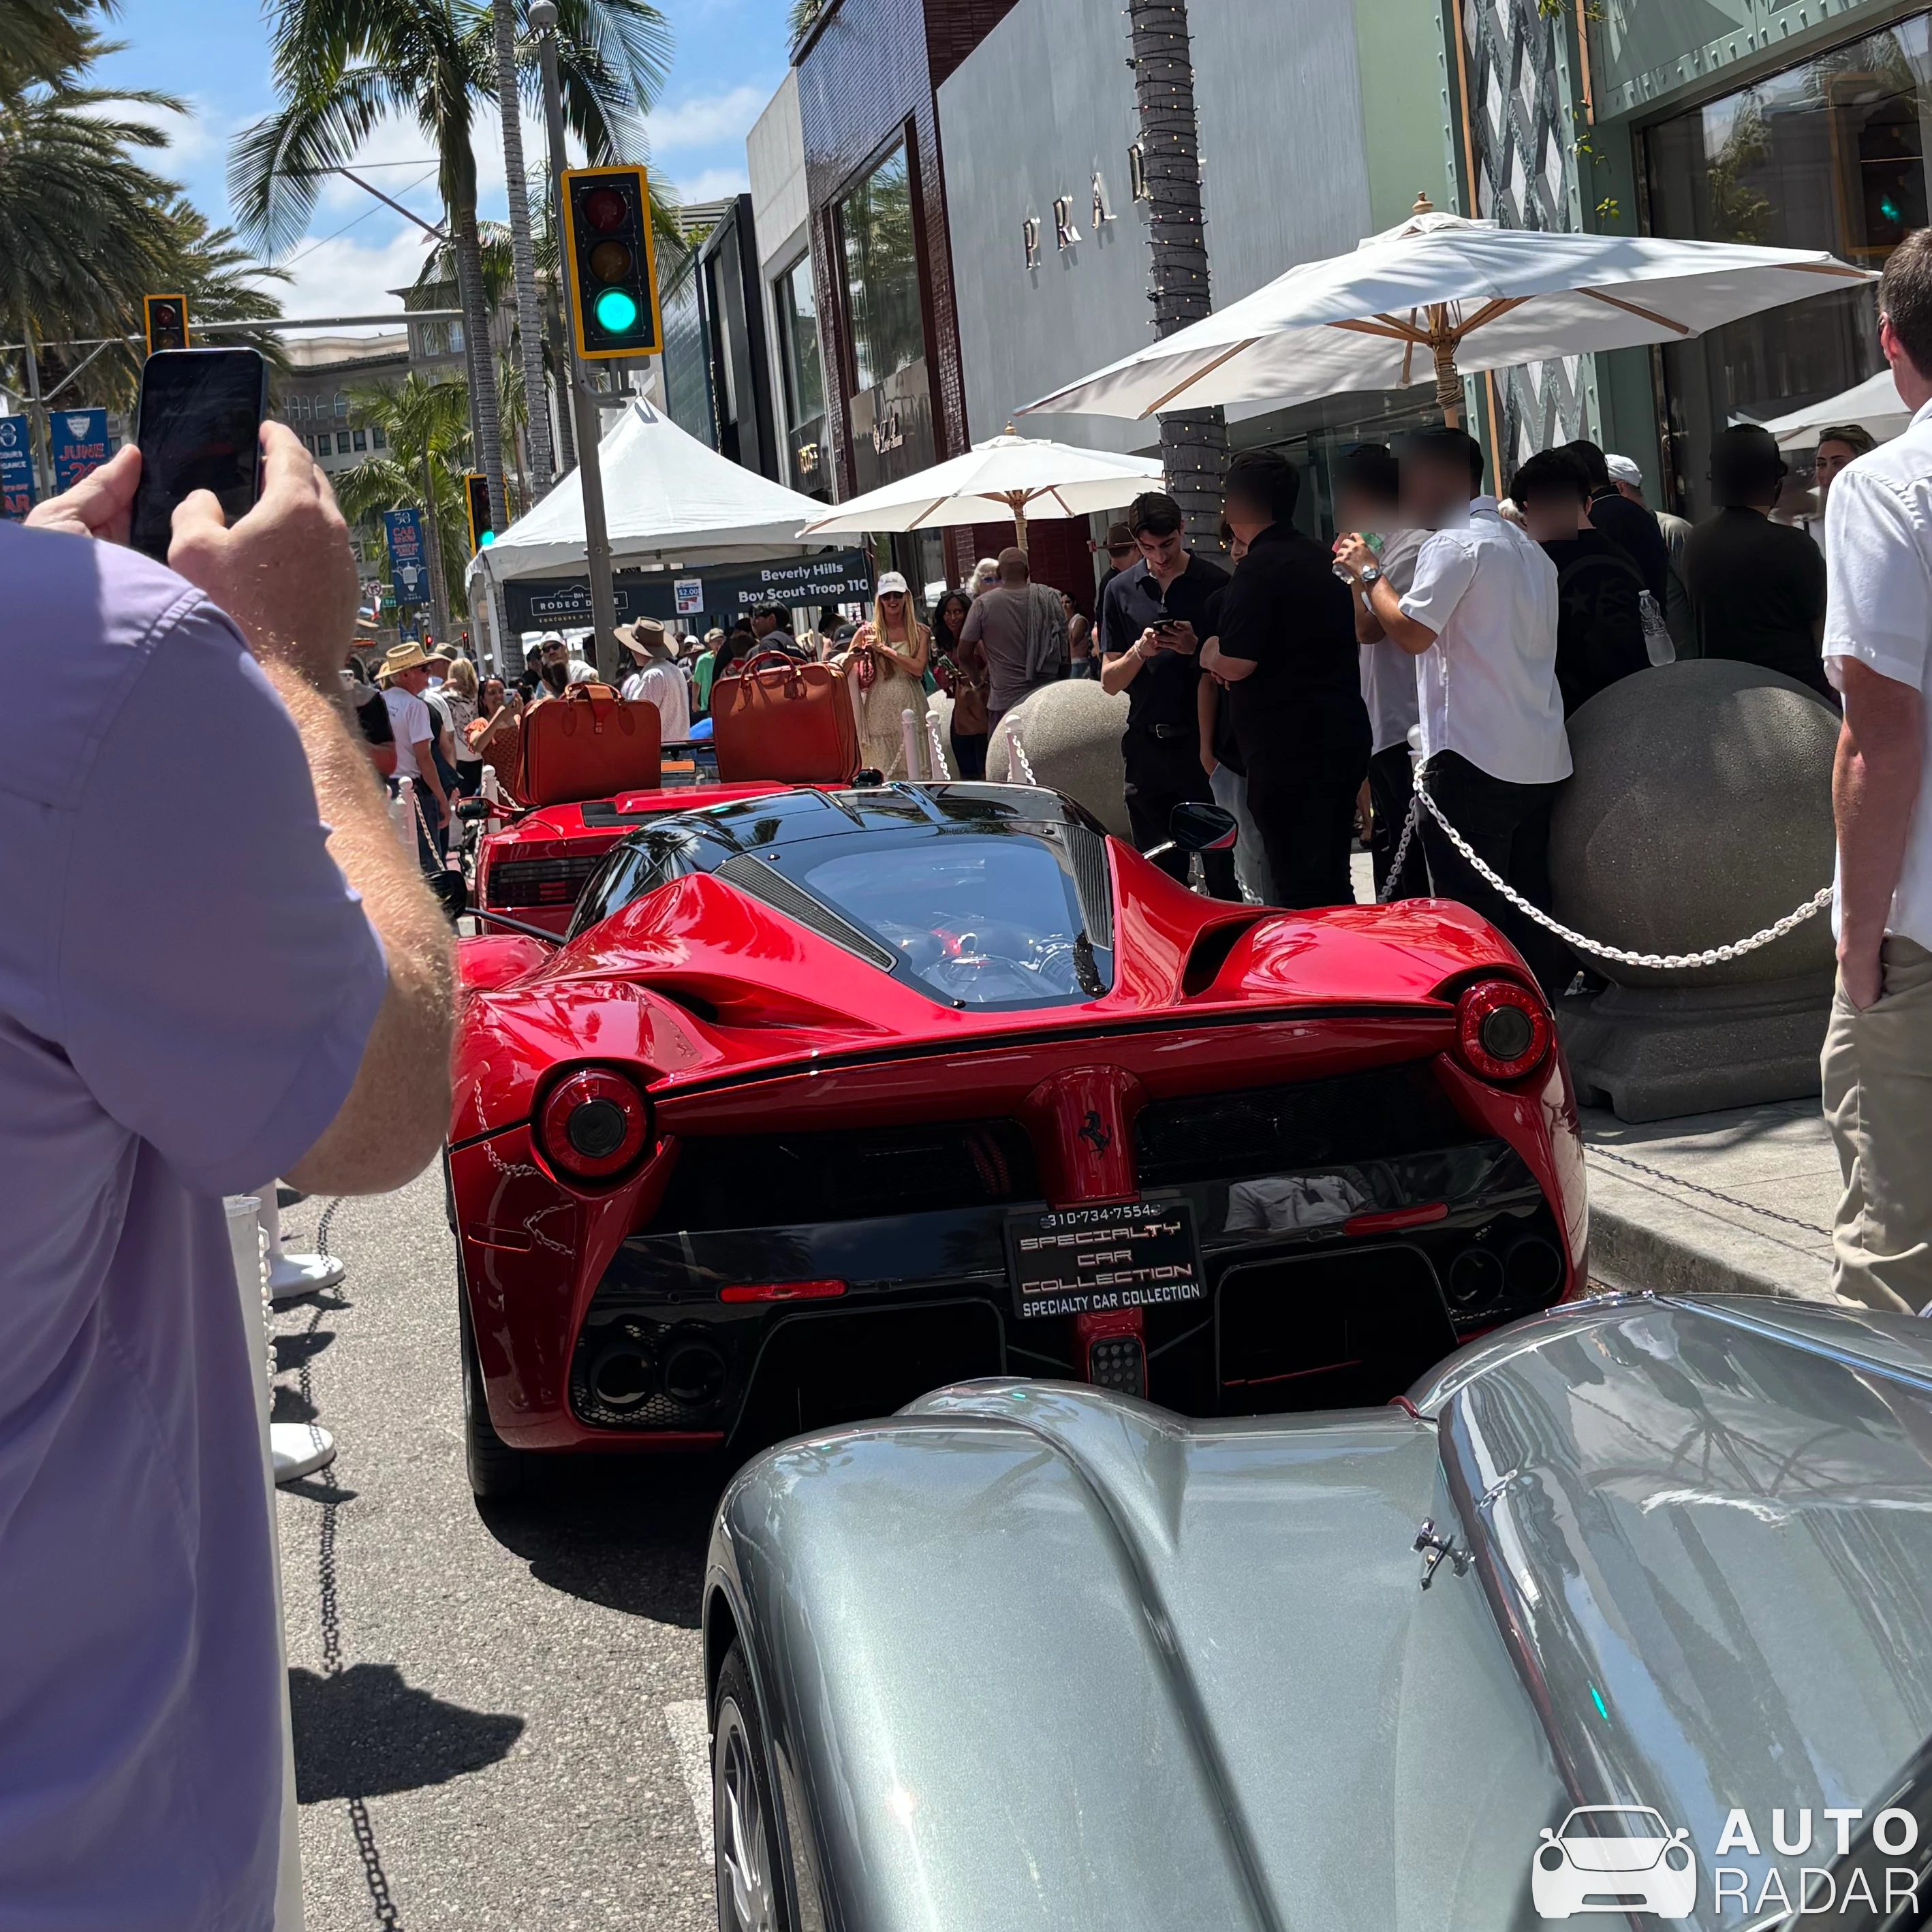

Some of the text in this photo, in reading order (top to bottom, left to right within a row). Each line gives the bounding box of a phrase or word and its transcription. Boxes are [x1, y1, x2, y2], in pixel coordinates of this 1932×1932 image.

[59, 443, 106, 461] JUNE
[761, 563, 843, 582] Beverly Hills
[767, 585, 806, 600] Scout
[807, 582, 845, 595] Troop
[847, 579, 869, 591] 110
[540, 600, 579, 610] RODEO
[1047, 1204, 1151, 1226] 310-734-7554
[1020, 1221, 1181, 1251] SPECIALTY
[1077, 1249, 1133, 1268] CAR
[1022, 1264, 1194, 1295] COLLECTION
[1023, 1283, 1200, 1318] SPECIALTY CAR COLLECTION
